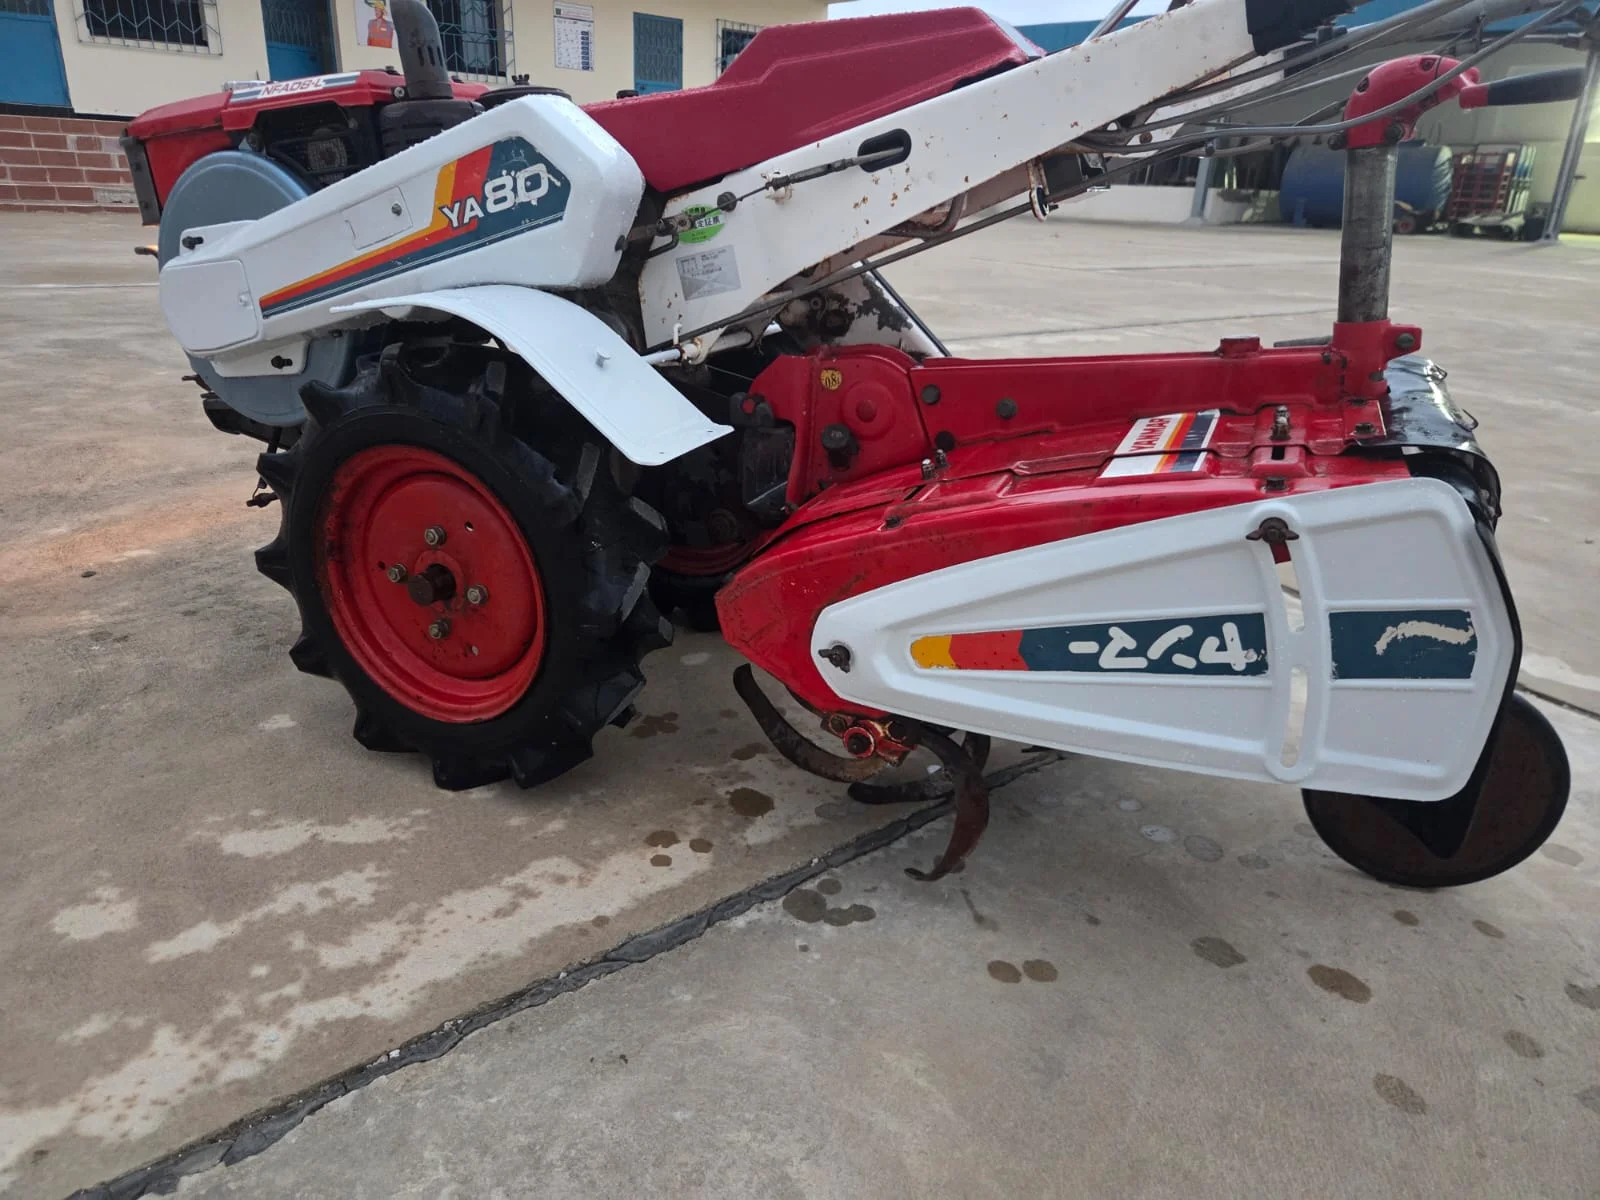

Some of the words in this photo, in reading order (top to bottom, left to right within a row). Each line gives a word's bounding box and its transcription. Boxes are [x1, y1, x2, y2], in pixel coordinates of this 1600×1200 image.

[439, 163, 549, 228] YA80
[1128, 417, 1173, 452] YANMAR
[1069, 622, 1259, 670] ヤンマー
